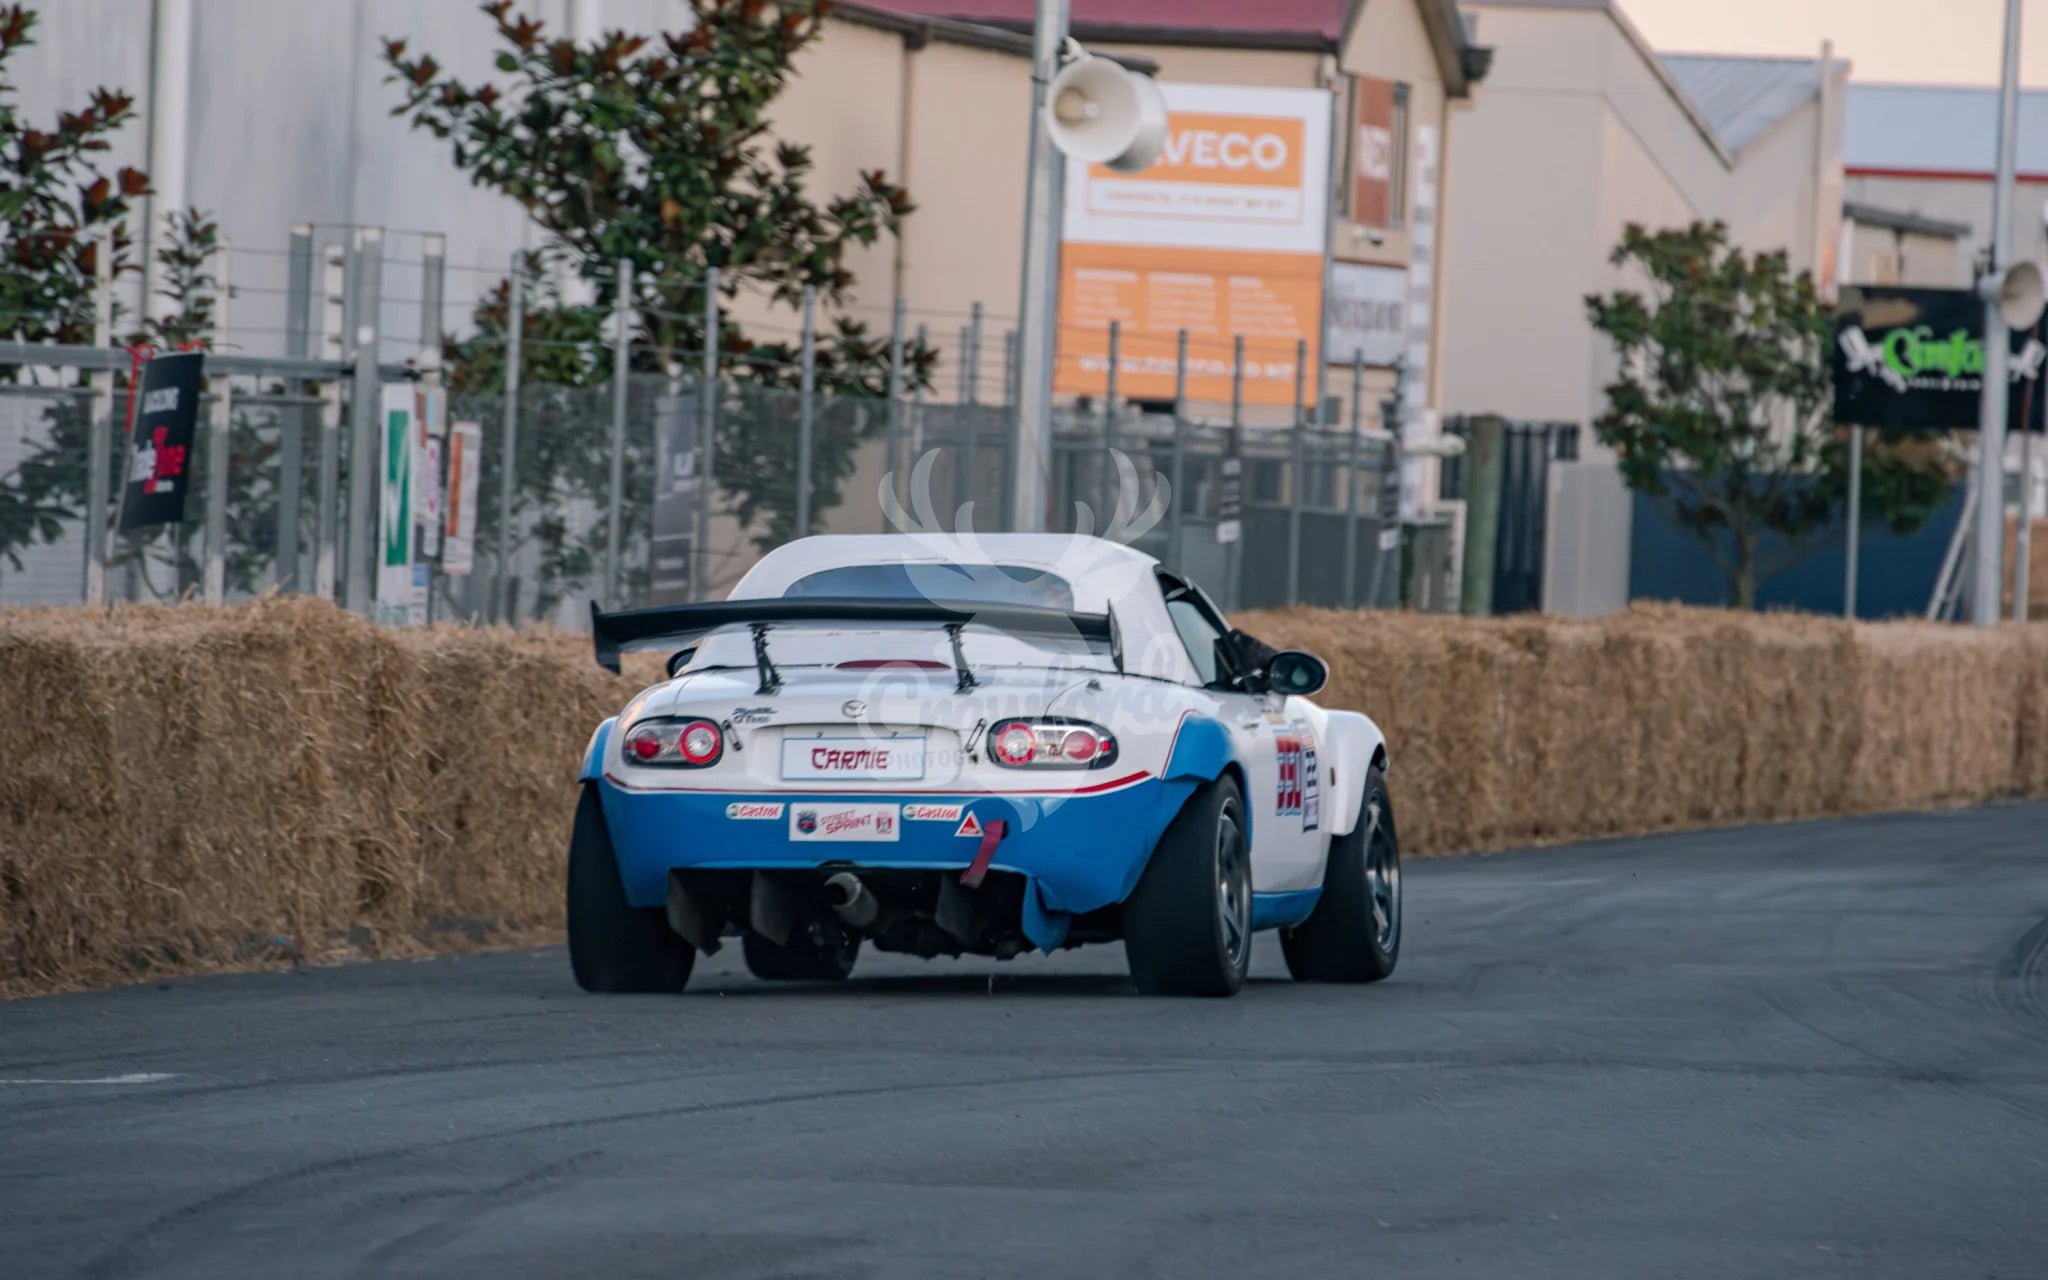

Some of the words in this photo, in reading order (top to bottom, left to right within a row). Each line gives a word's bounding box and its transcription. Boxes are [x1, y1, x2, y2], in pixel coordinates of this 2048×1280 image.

[1156, 129, 1289, 172] VECO
[811, 747, 890, 770] CARMIE
[738, 804, 780, 818] Castrol
[917, 806, 959, 820] Castrol
